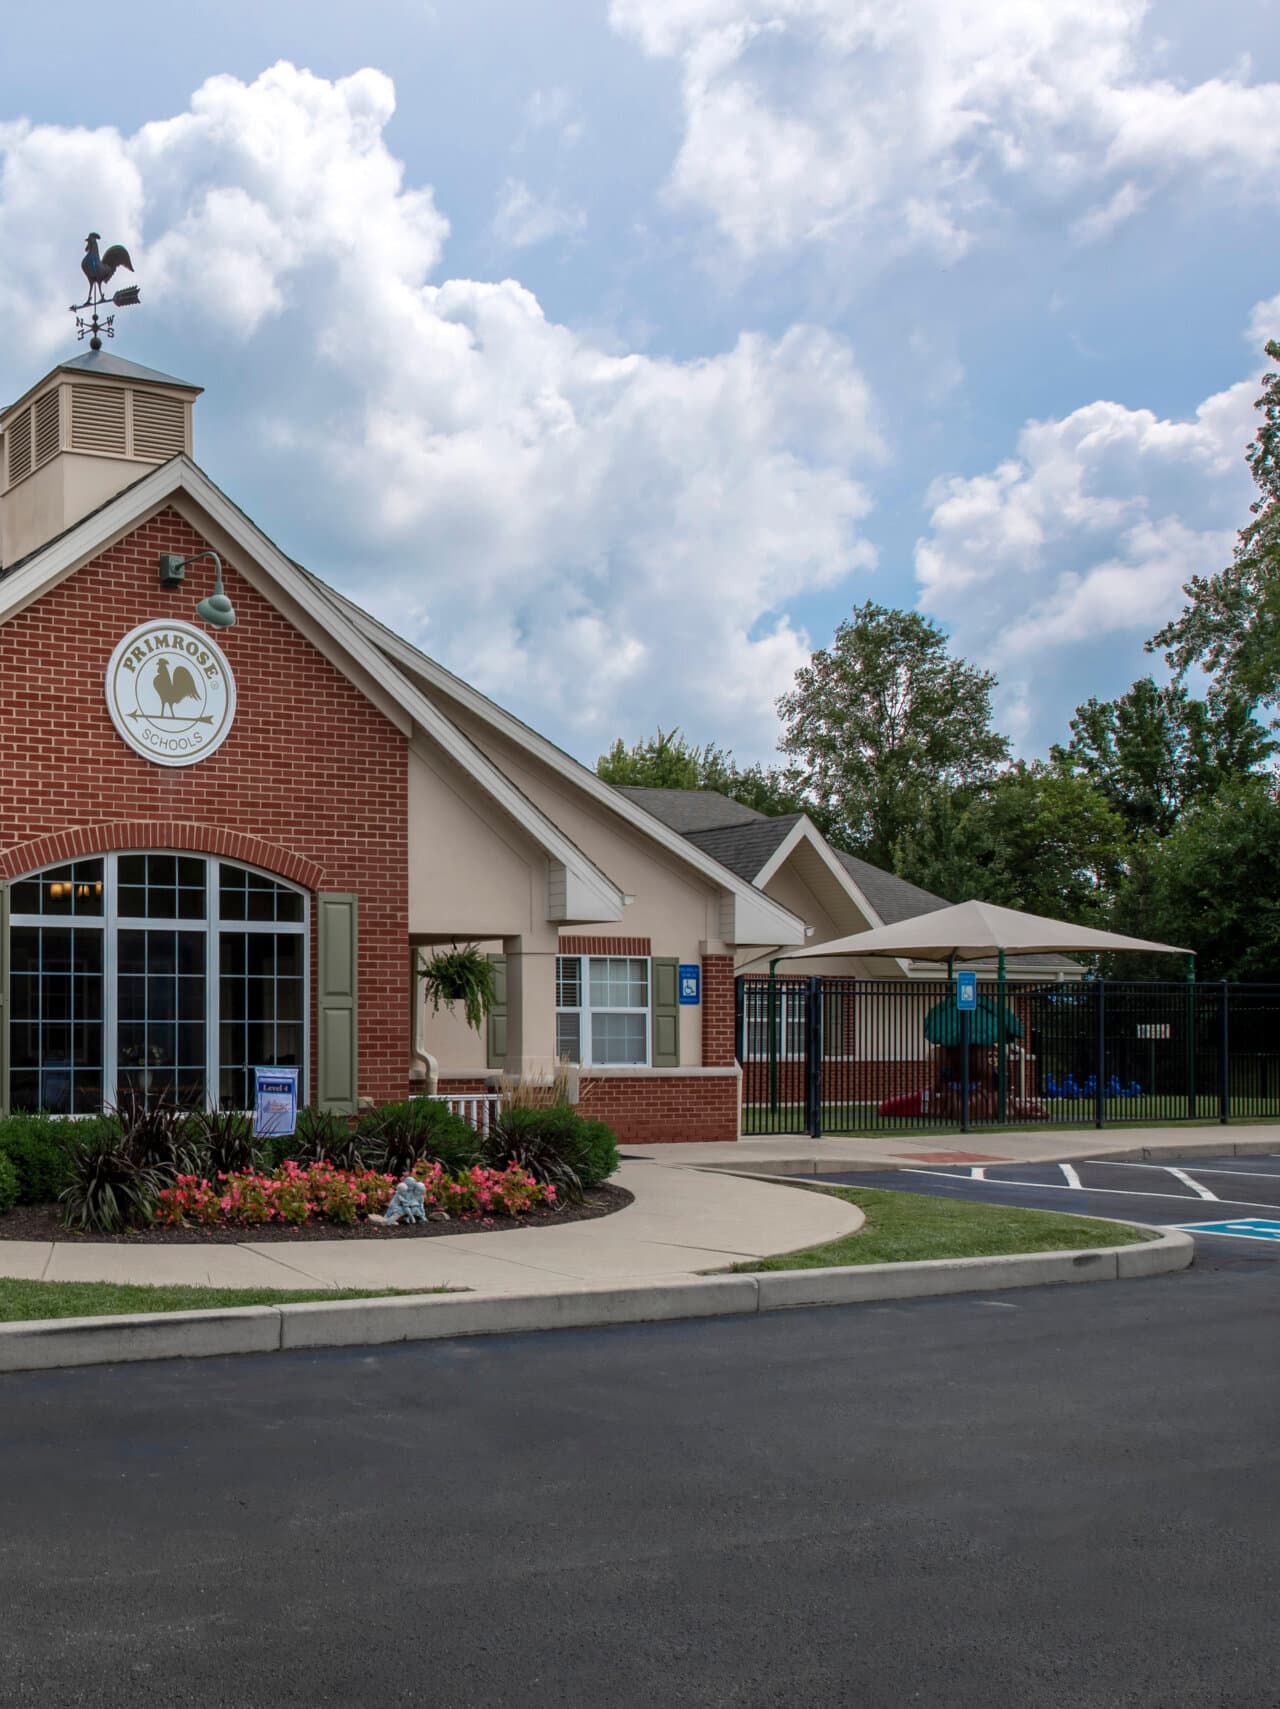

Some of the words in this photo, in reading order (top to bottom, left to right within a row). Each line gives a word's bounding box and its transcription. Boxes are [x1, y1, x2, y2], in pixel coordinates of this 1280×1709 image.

[76, 316, 84, 328] N
[106, 314, 115, 326] W
[107, 327, 115, 338] S
[123, 633, 219, 680] PRIMROSE
[141, 728, 204, 752] SCHOOLS
[263, 1084, 282, 1092] Level
